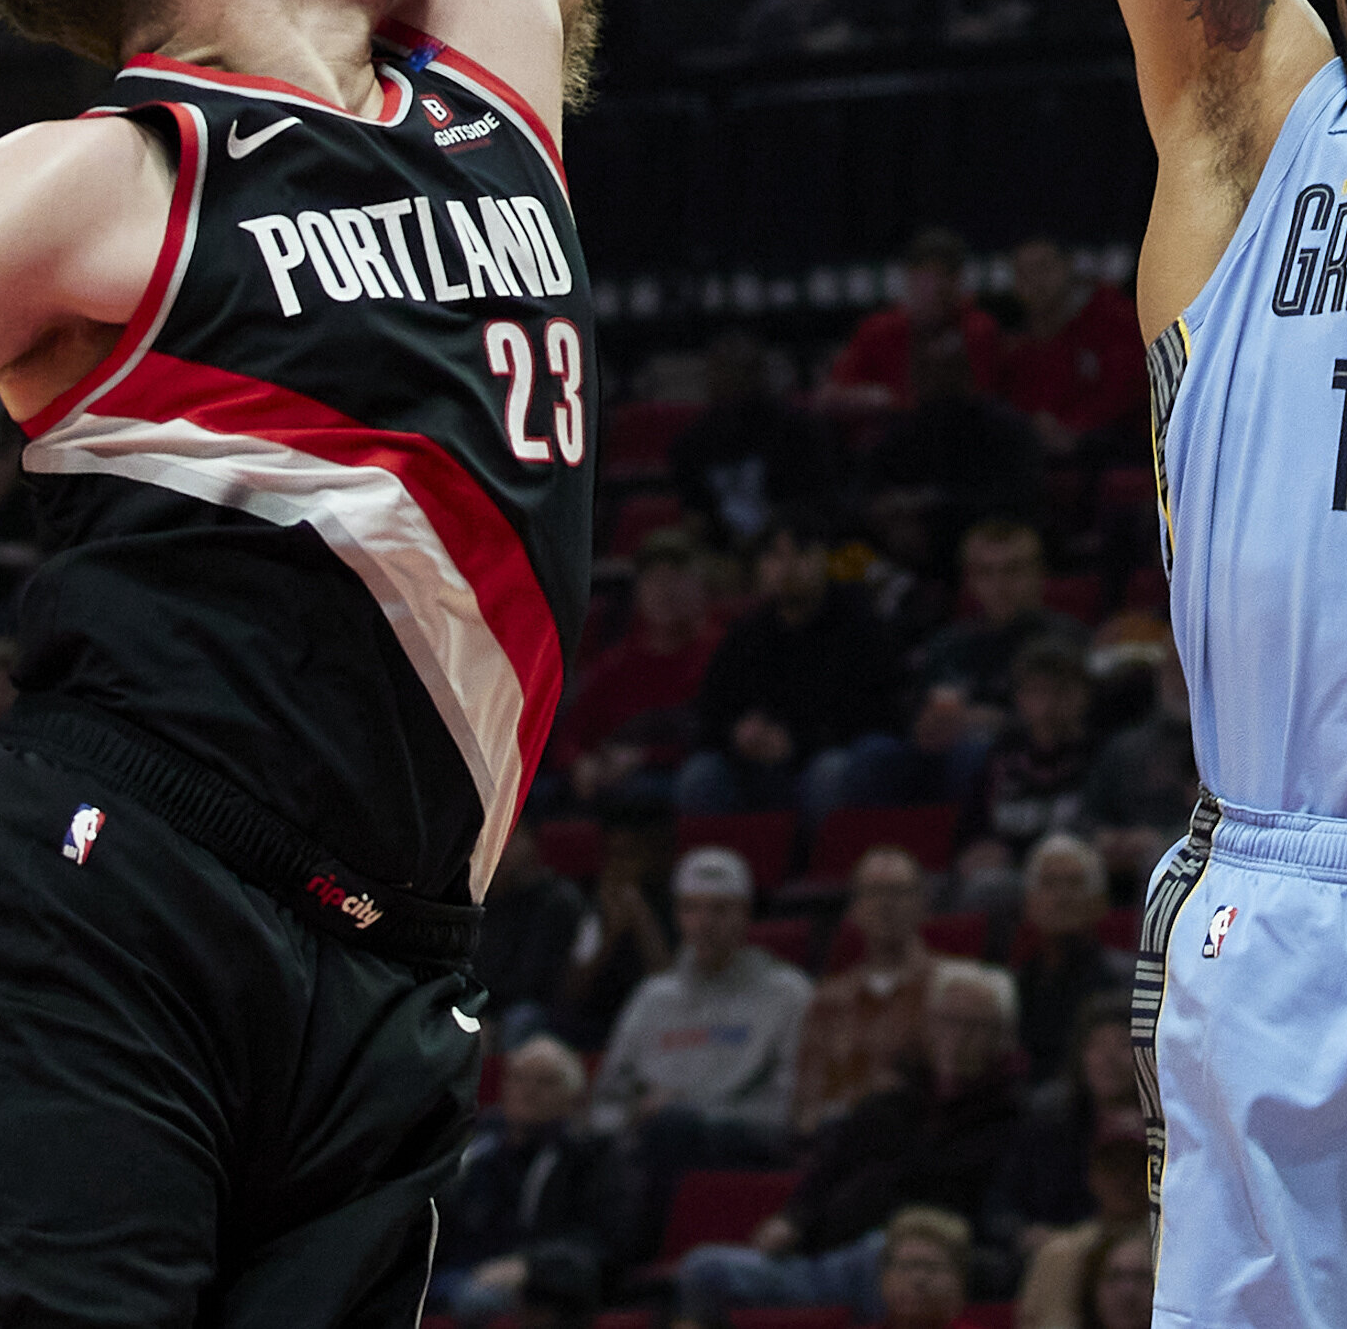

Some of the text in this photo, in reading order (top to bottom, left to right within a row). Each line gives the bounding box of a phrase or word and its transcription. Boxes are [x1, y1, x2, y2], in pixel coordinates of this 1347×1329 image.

[434, 111, 501, 147] GHTSIDE
[238, 195, 573, 318] PORTLAND
[483, 317, 586, 468] 23
